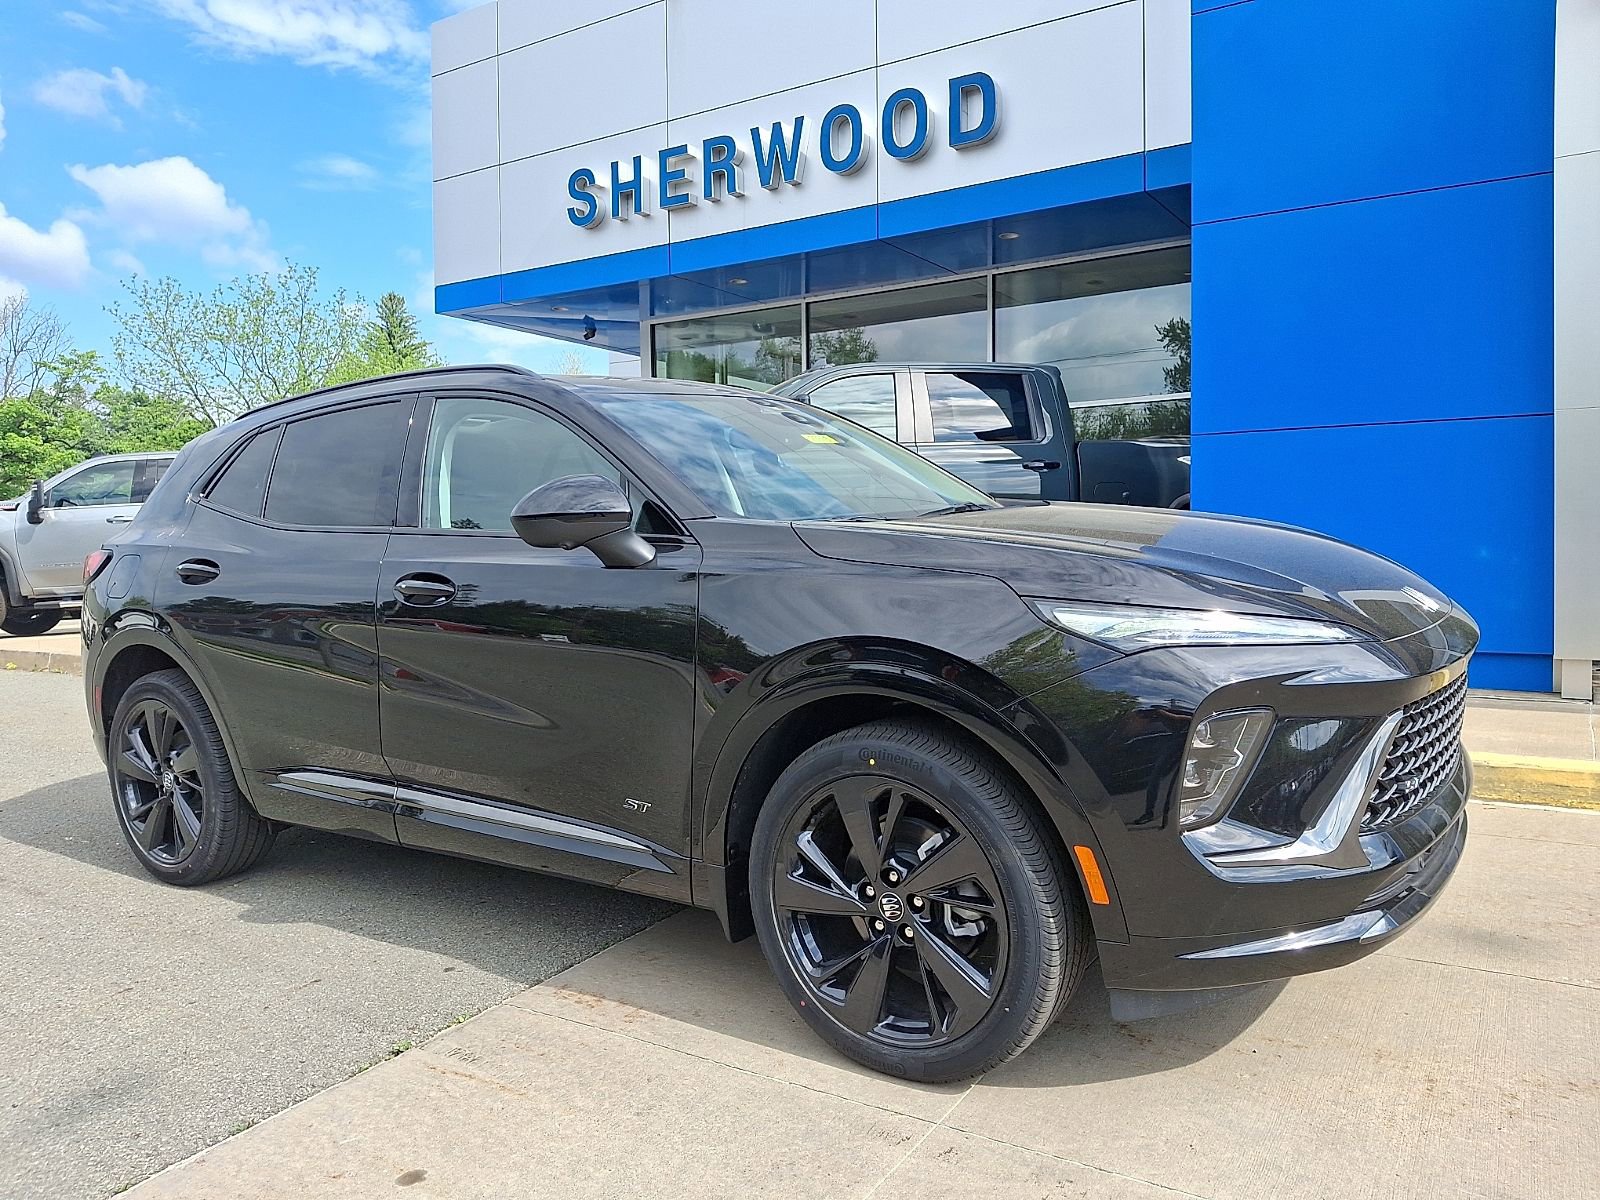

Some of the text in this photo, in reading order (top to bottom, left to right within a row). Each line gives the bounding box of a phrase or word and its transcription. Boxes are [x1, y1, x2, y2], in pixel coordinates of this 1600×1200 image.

[566, 71, 999, 228] SHERWOOD
[858, 747, 926, 772] Continental
[622, 798, 652, 813] ST
